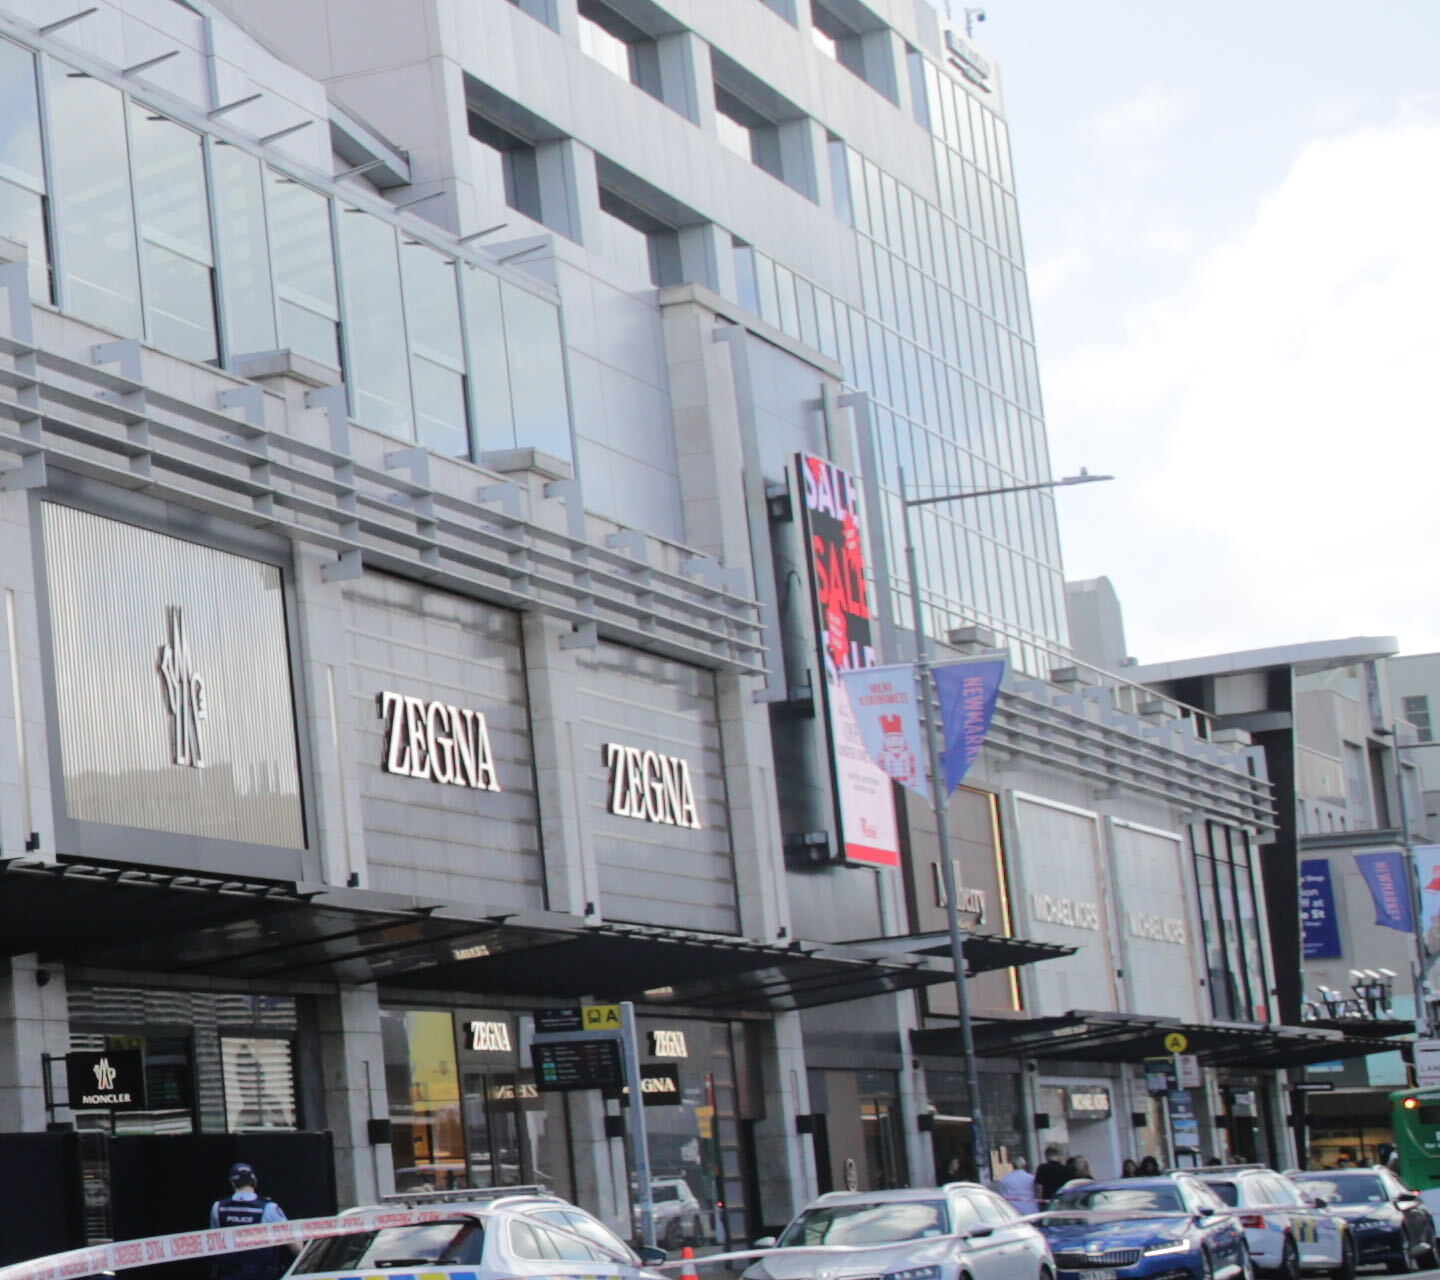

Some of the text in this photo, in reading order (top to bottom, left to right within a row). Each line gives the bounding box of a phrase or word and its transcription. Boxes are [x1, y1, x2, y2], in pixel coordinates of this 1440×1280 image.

[382, 690, 502, 793] ZEGNA
[606, 742, 702, 830] ZEGNA
[605, 1009, 618, 1023] A
[470, 1020, 512, 1052] ZEGNA
[653, 1030, 689, 1058] ZEGNA
[1170, 1037, 1181, 1048] A
[82, 1093, 132, 1105] MONCLER
